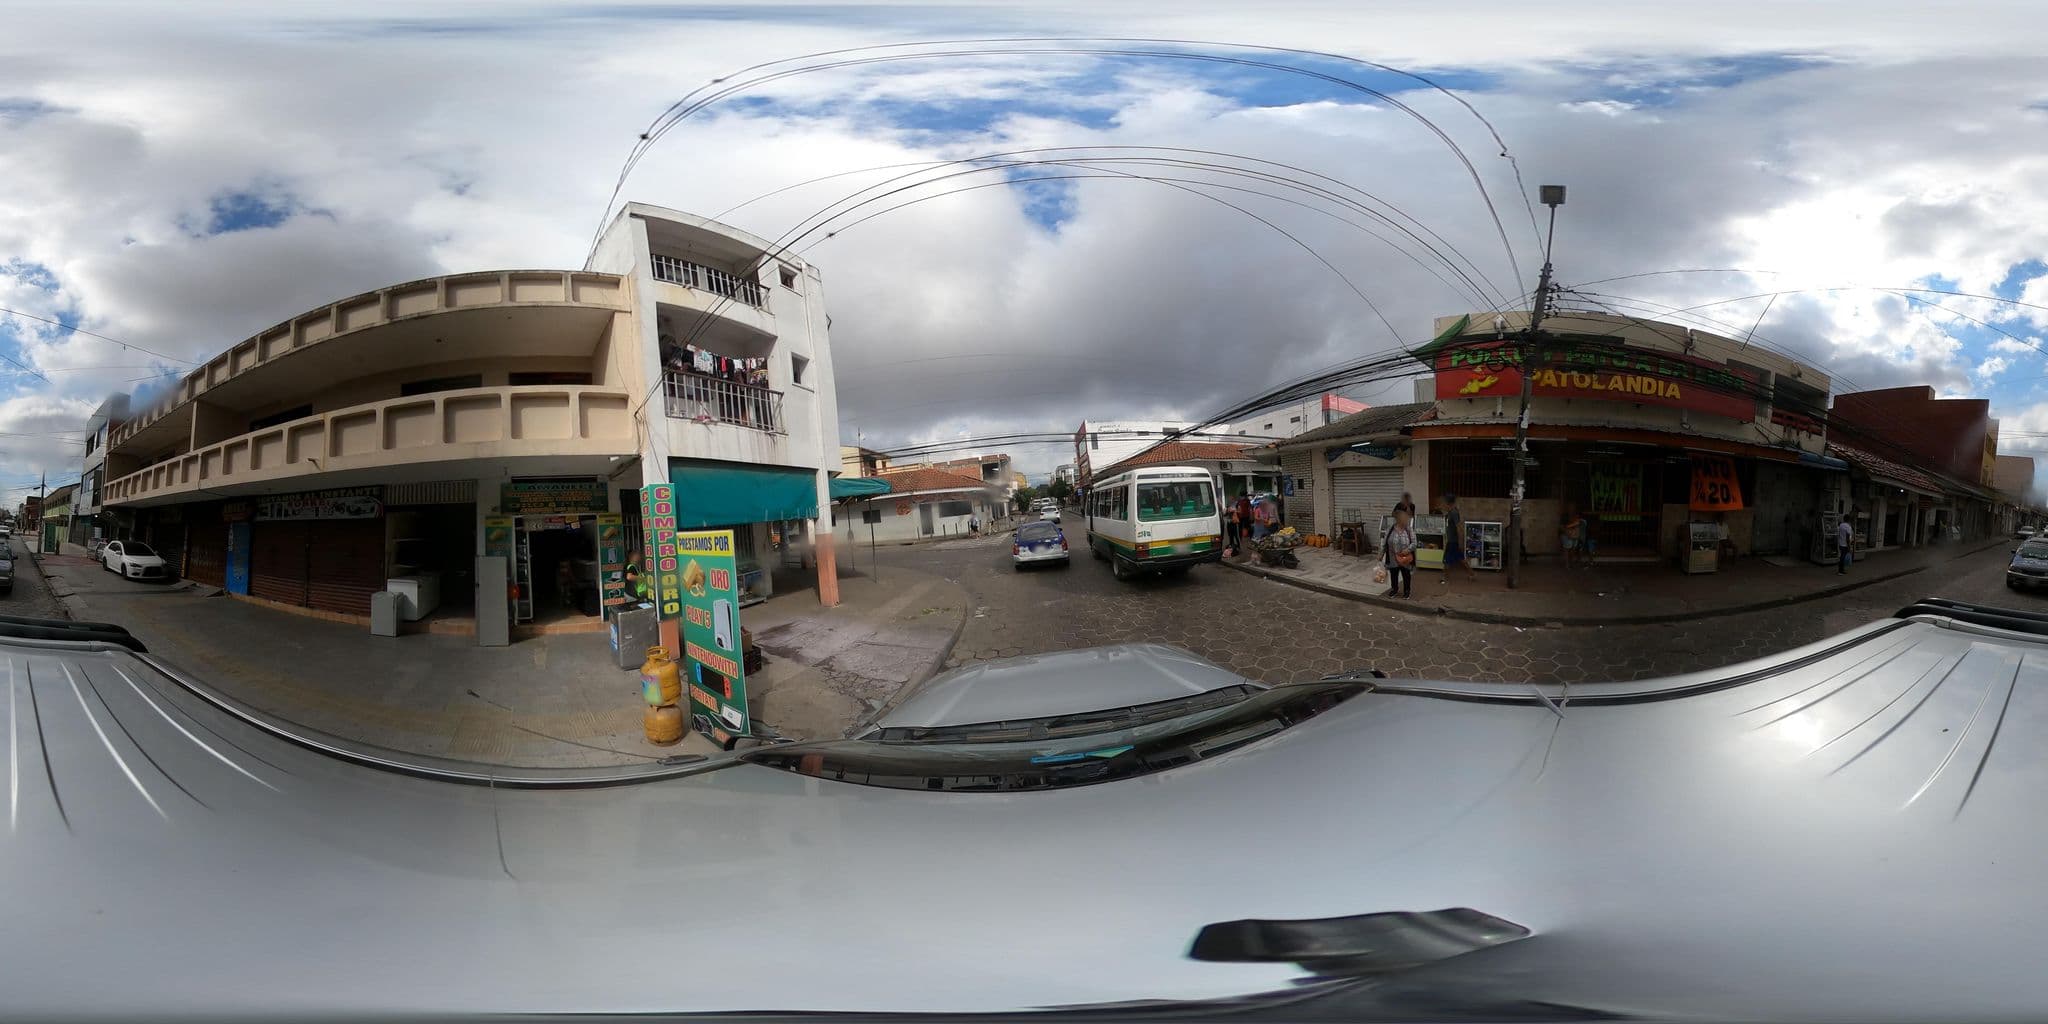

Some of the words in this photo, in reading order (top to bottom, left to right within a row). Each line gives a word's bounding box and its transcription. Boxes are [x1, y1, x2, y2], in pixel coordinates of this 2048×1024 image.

[1531, 367, 1682, 402] PATOLANDIA
[654, 487, 677, 572] COMPRO
[678, 536, 712, 552] PRESTAMOS
[714, 535, 730, 550] POR
[710, 569, 731, 590] ORO
[661, 574, 680, 615] ORO
[686, 605, 704, 626] PLAY
